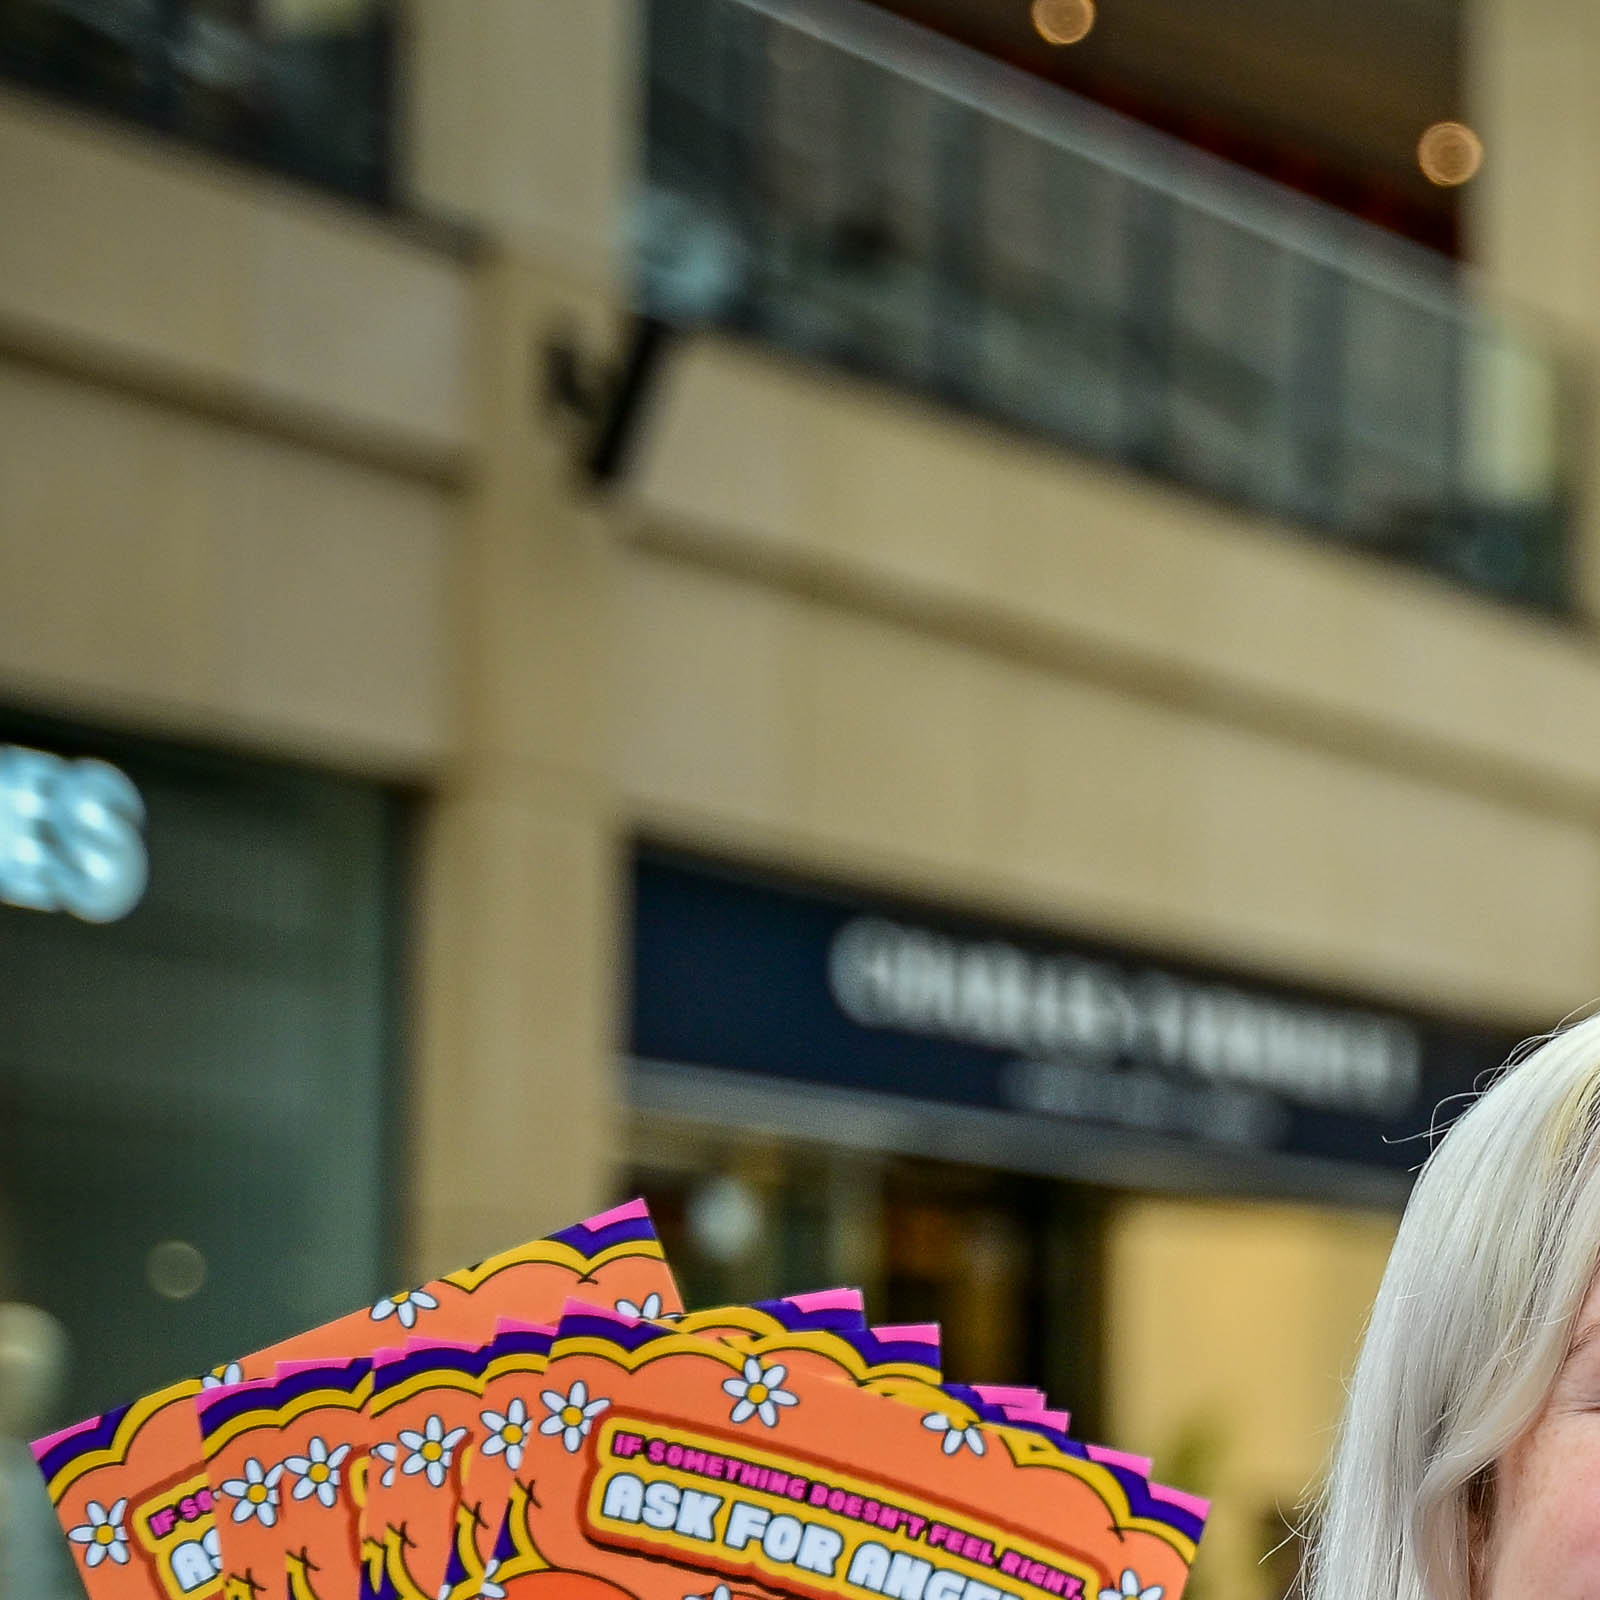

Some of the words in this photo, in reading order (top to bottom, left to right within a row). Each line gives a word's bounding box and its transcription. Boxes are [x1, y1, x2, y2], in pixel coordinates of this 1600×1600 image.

[602, 1472, 724, 1542] ASK
[723, 1500, 845, 1577] FOR
[611, 1431, 646, 1459] IF
[648, 1438, 808, 1502] SOMETHING
[808, 1481, 928, 1540] DOESN'T
[927, 1520, 997, 1567] FEEL
